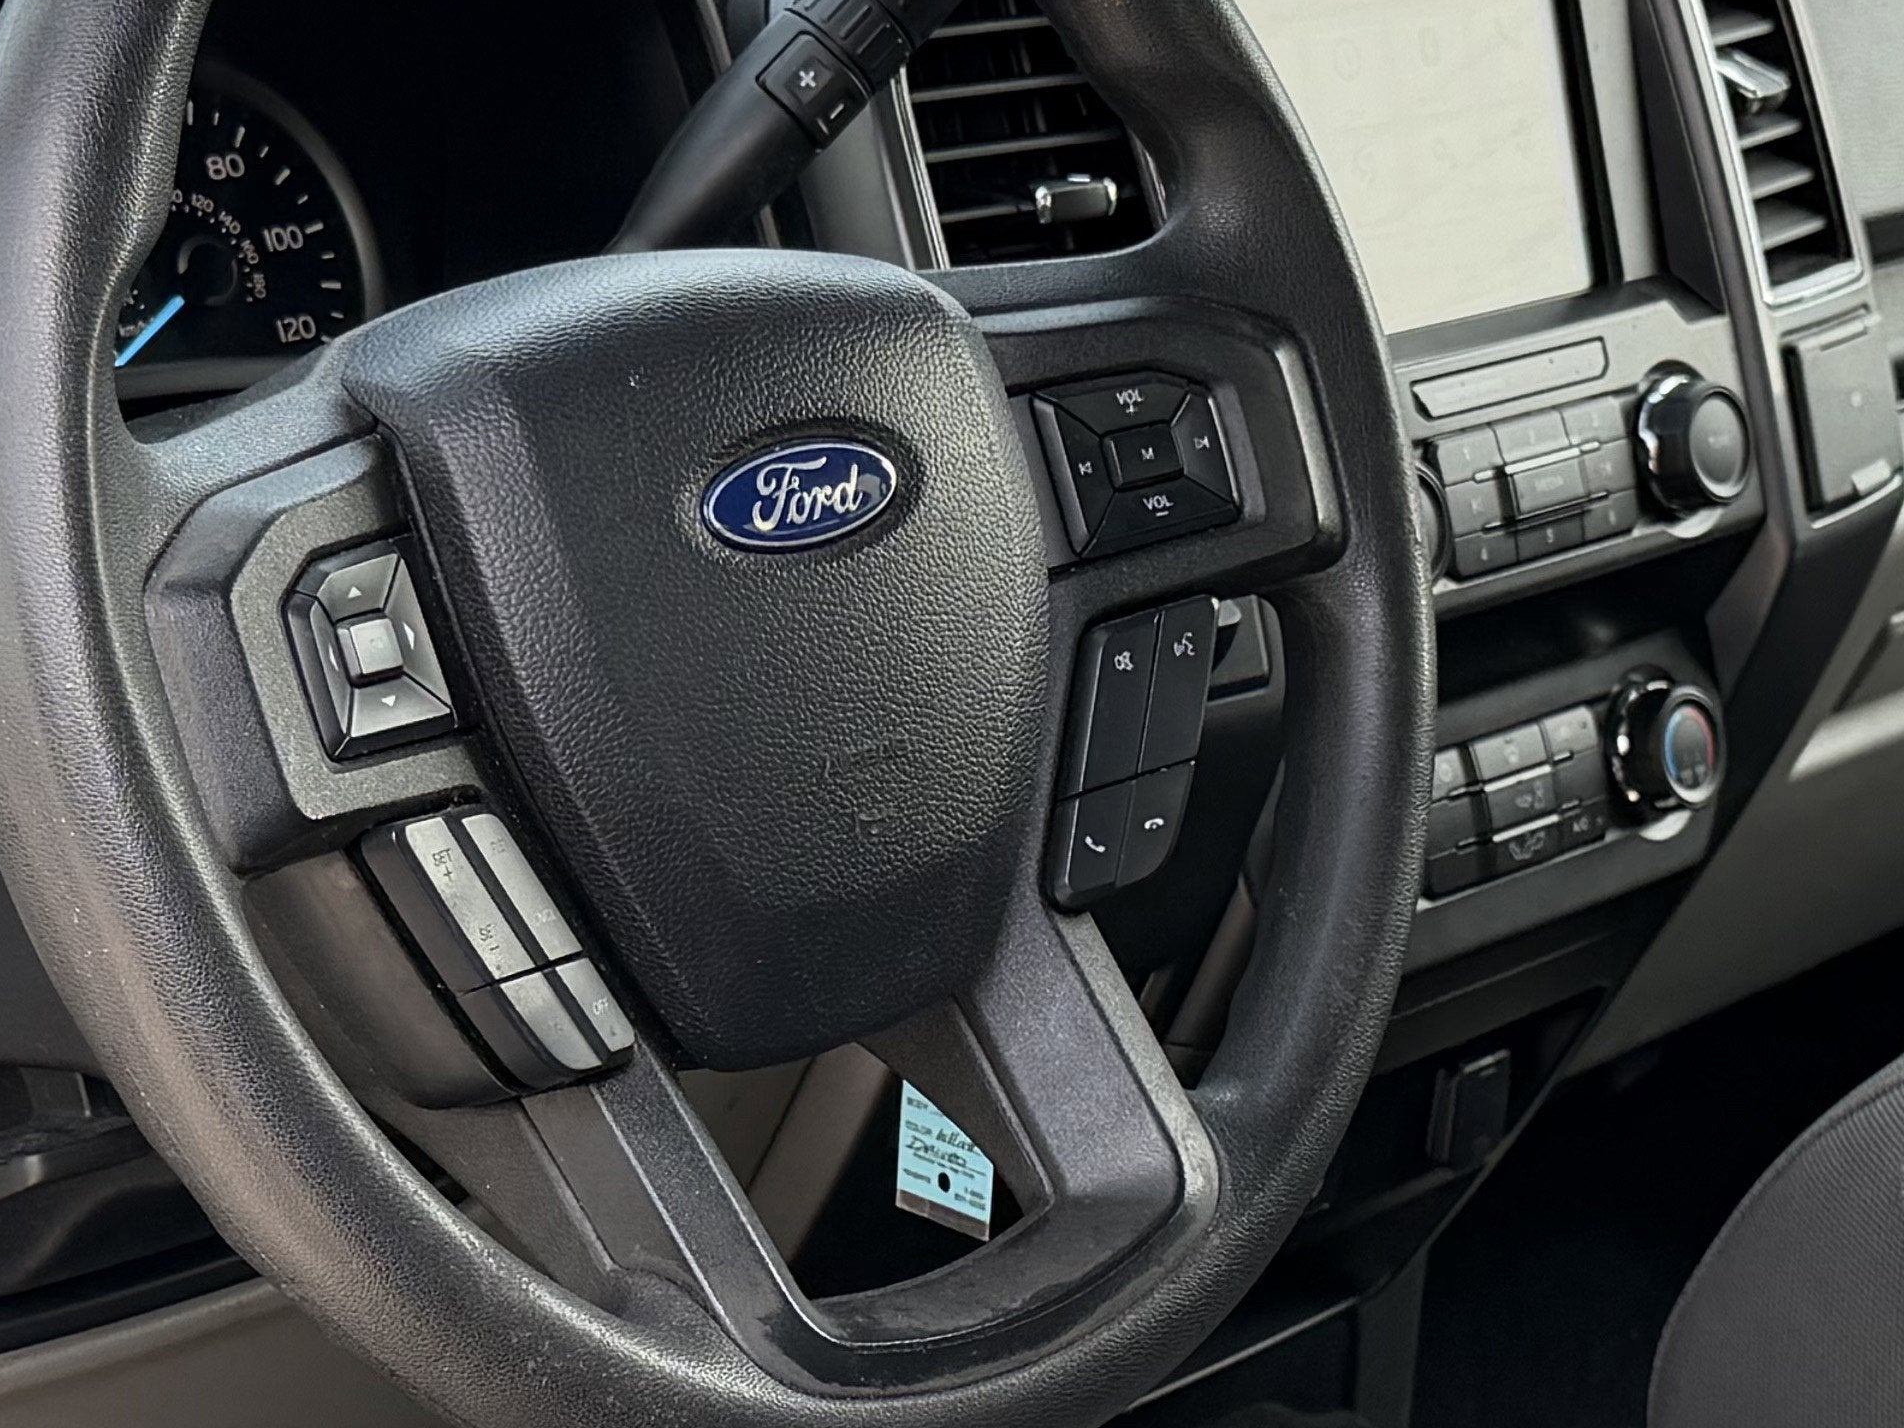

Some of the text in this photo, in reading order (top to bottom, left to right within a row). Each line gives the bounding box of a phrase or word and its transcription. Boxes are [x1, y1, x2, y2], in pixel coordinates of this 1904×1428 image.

[206, 153, 245, 180] 80
[191, 192, 215, 213] 120
[219, 210, 242, 235] 140
[262, 225, 304, 253] 100
[276, 315, 317, 344] 120
[1116, 388, 1145, 406] VOL
[751, 455, 863, 532] Ford
[1142, 494, 1175, 511] VOL
[431, 848, 452, 867] SET
